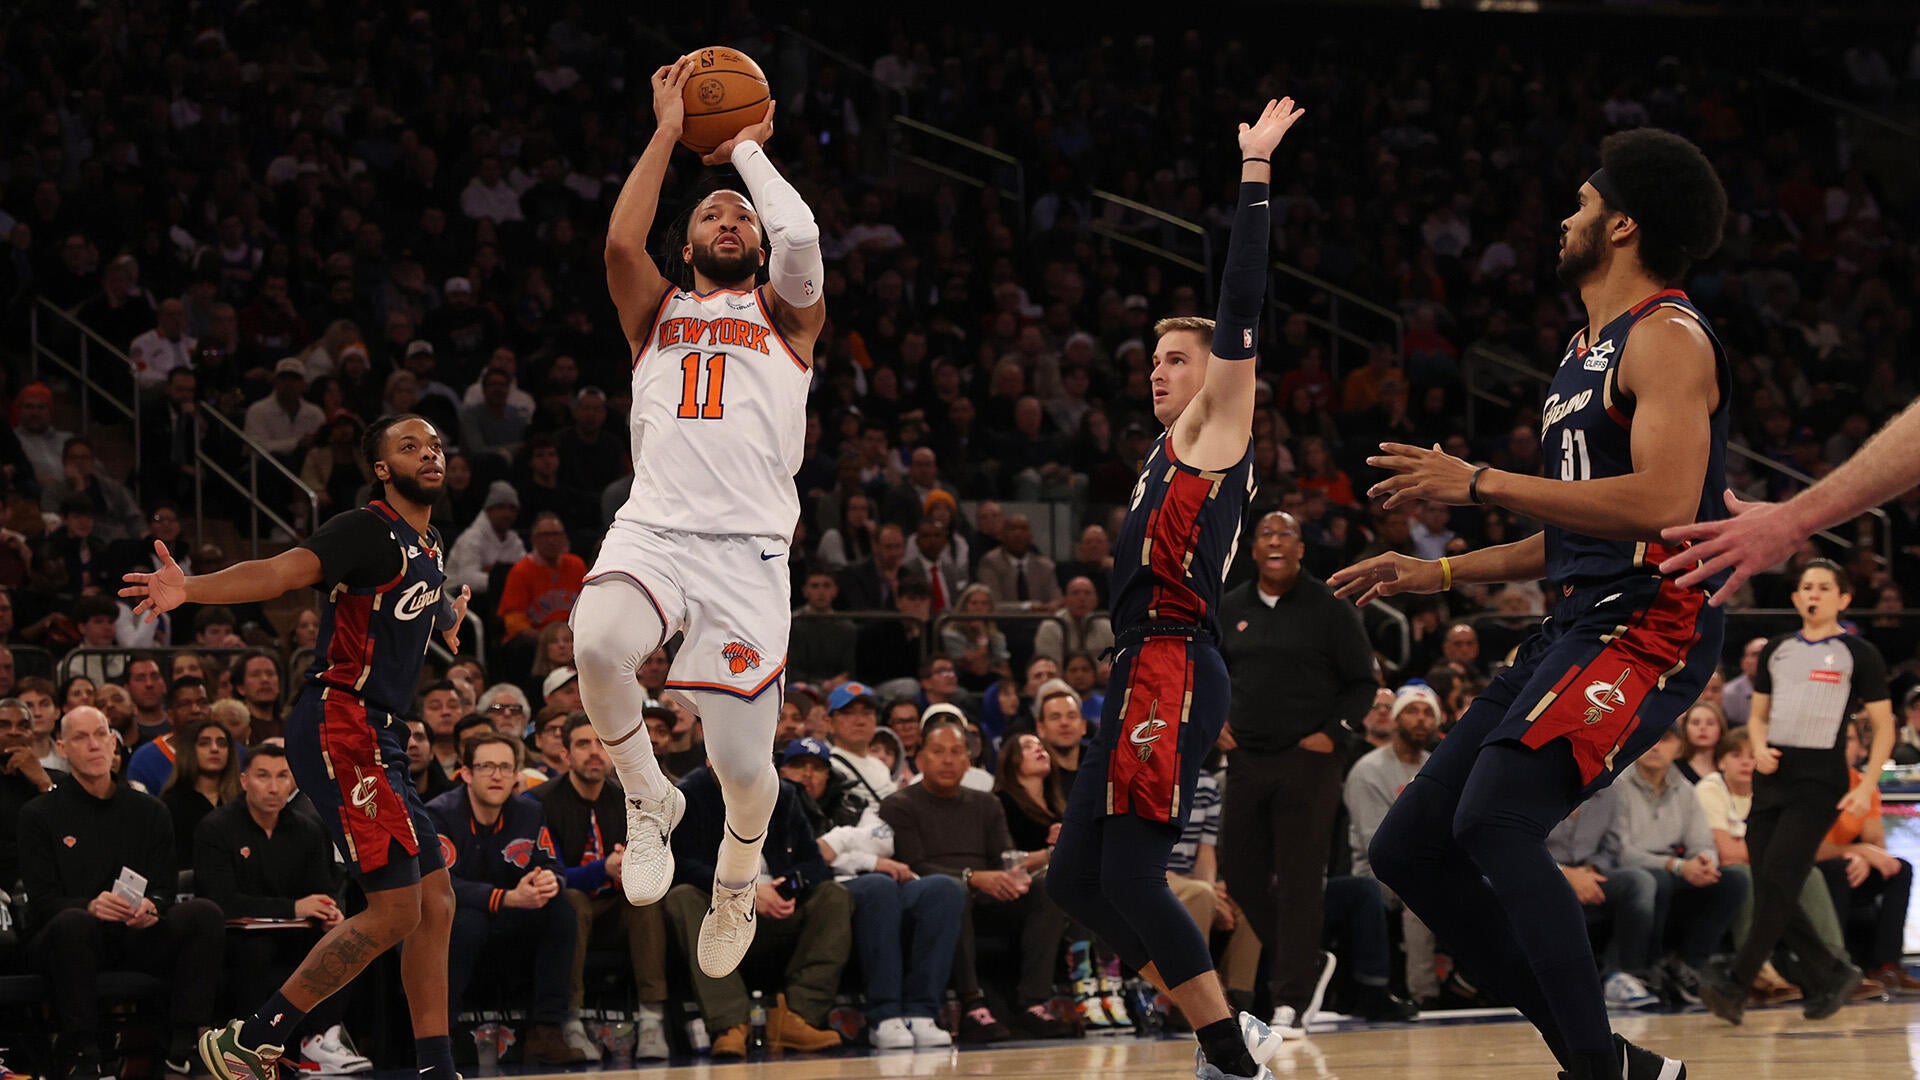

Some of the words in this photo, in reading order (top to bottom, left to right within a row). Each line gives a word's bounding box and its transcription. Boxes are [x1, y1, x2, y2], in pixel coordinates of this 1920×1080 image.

[657, 317, 708, 352] NEW
[707, 317, 771, 356] YORK
[1585, 359, 1608, 370] CLIFFS
[677, 352, 726, 420] 11
[1560, 428, 1592, 482] 31
[722, 641, 760, 669] KNICKS
[536, 825, 557, 860] 4
